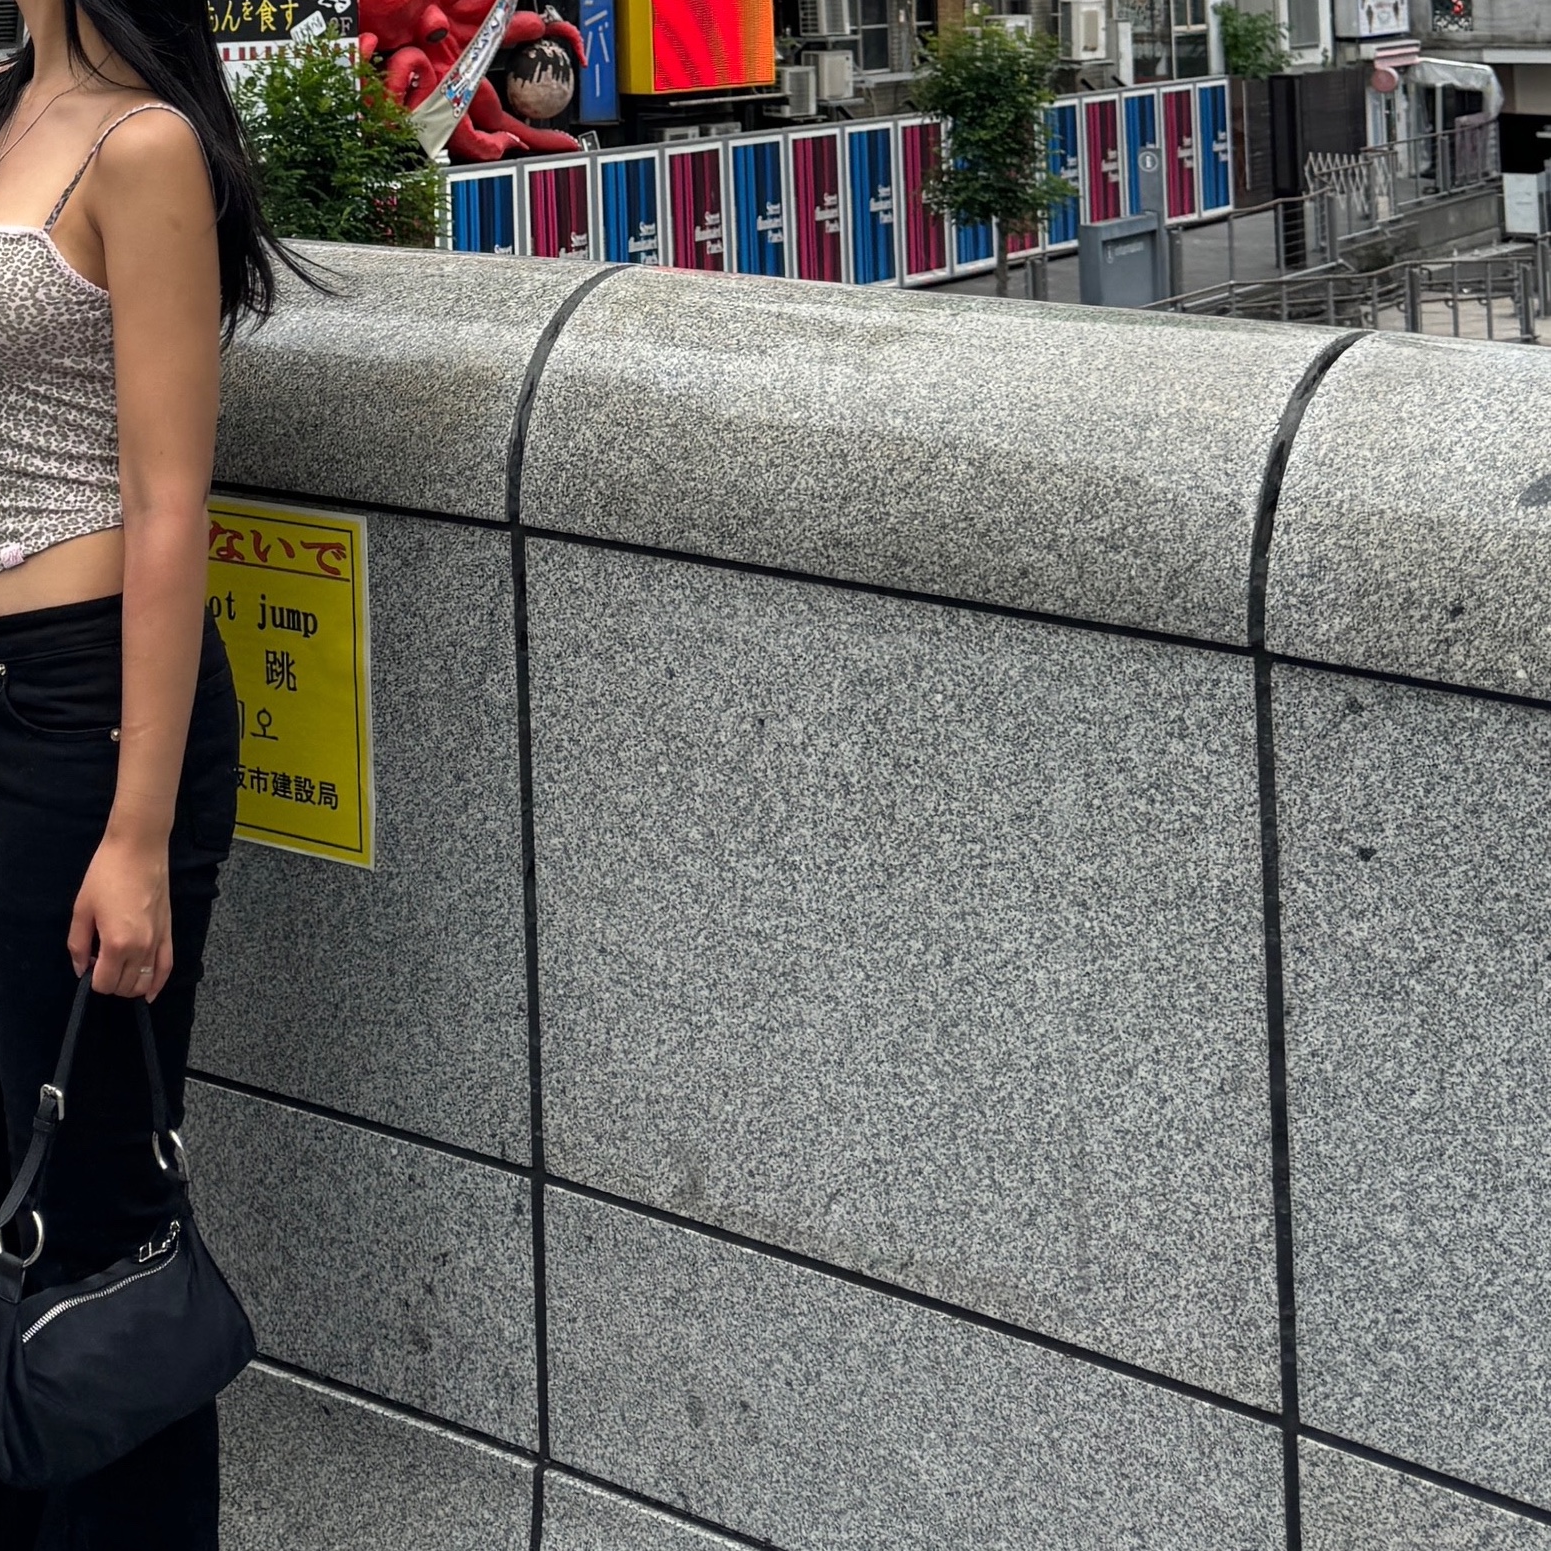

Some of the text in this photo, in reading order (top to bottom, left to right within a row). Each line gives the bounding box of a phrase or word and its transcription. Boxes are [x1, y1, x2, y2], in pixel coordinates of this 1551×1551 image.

[208, 590, 318, 638] ot jump
[265, 649, 298, 692] 跳
